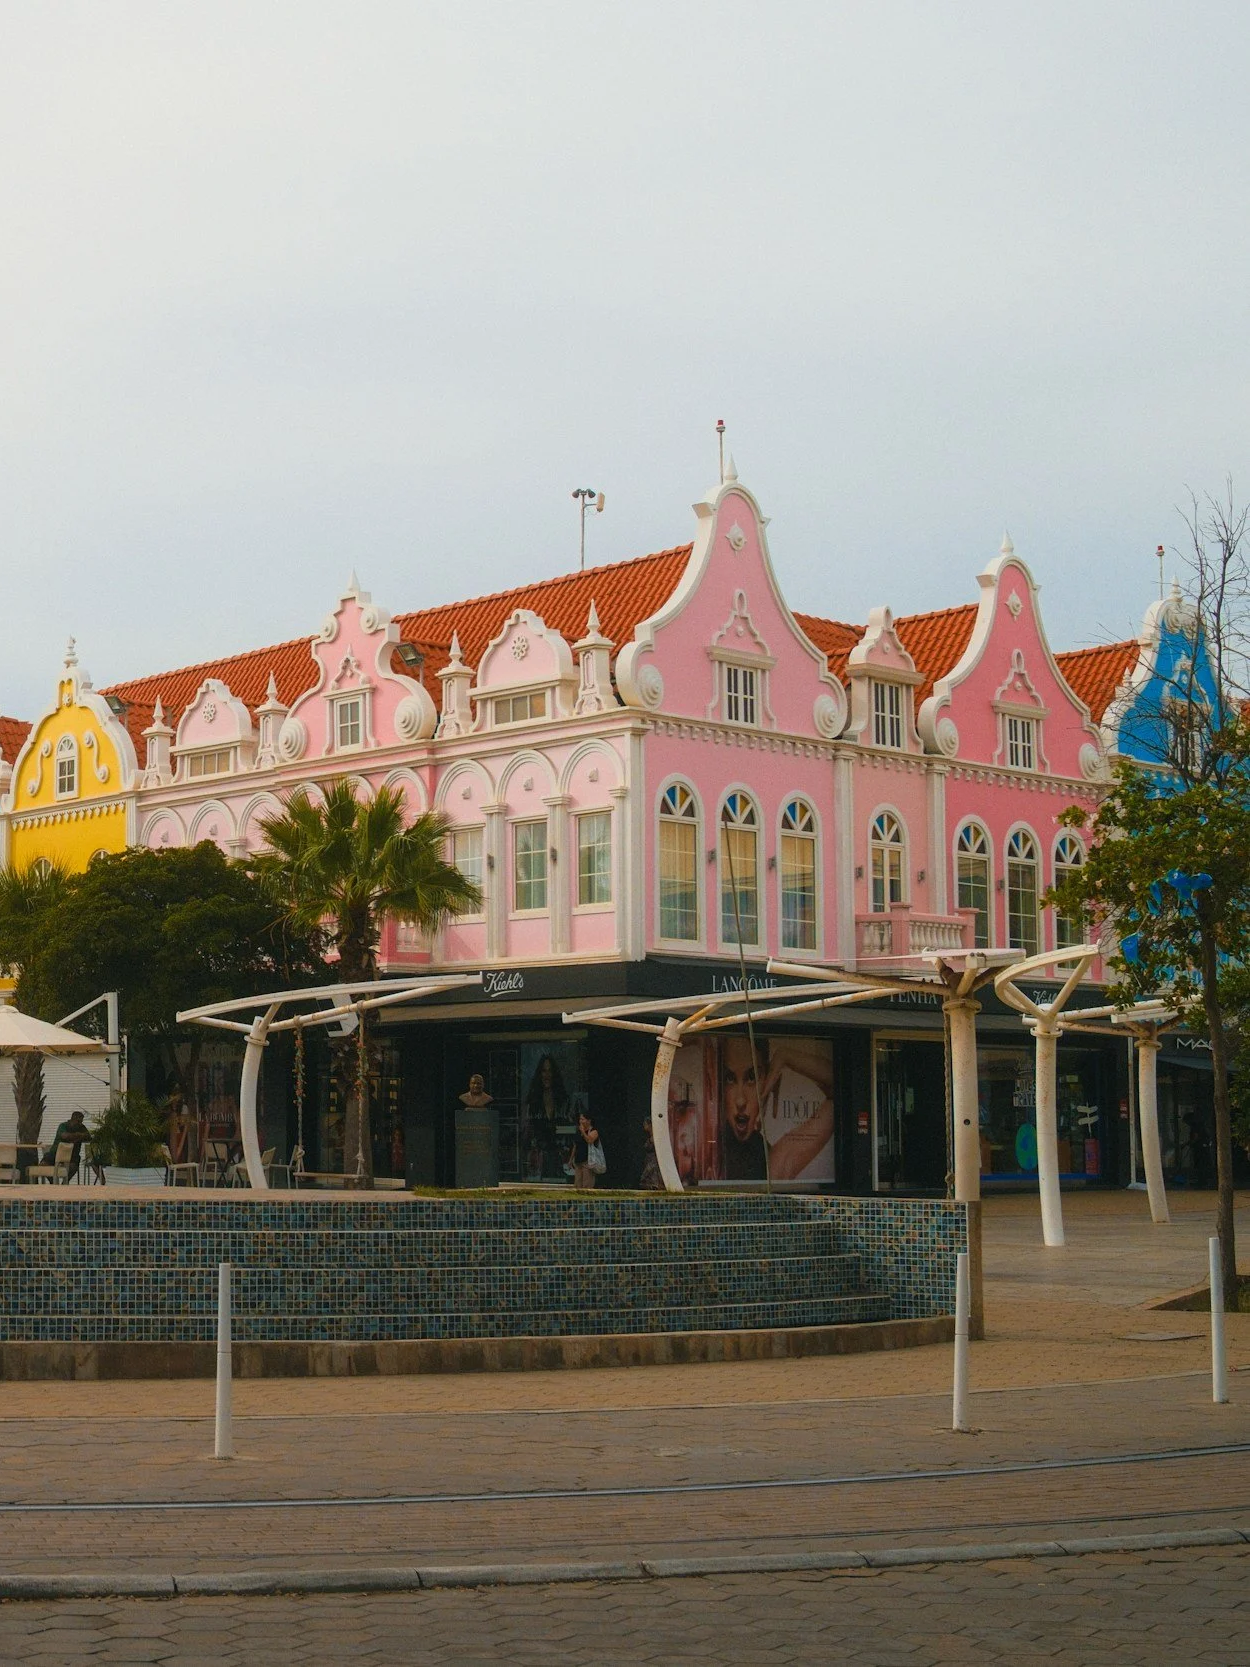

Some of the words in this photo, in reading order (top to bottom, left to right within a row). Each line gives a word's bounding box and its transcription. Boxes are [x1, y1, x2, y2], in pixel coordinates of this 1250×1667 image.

[483, 971, 524, 994] Kiehl's
[712, 974, 779, 993] LANCÔME
[1033, 990, 1058, 1005] Kiehl
